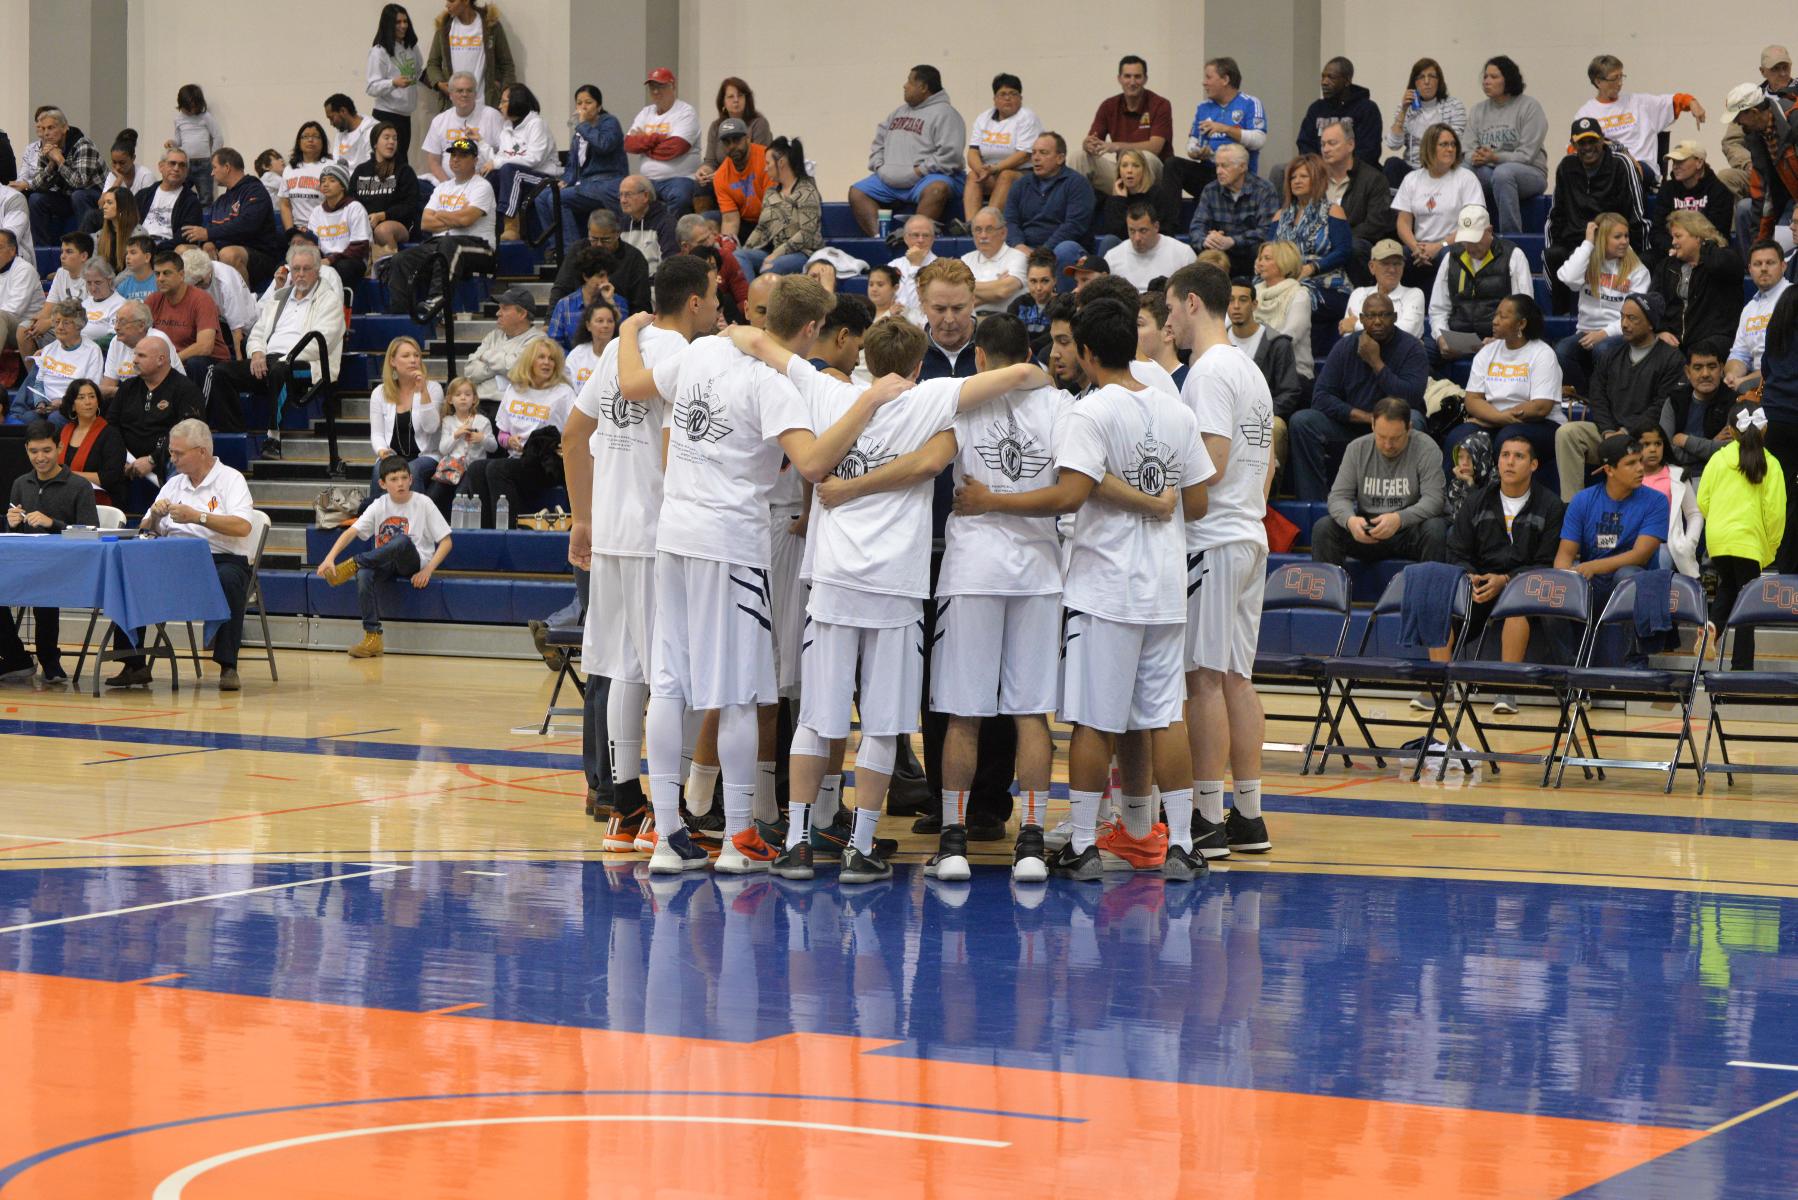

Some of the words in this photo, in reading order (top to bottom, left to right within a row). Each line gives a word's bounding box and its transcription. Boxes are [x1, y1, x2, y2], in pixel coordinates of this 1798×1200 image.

[1488, 361, 1529, 378] COS
[509, 400, 551, 421] COS
[1143, 466, 1160, 490] KRC
[1285, 567, 1325, 600] COS
[1525, 575, 1567, 608] COS
